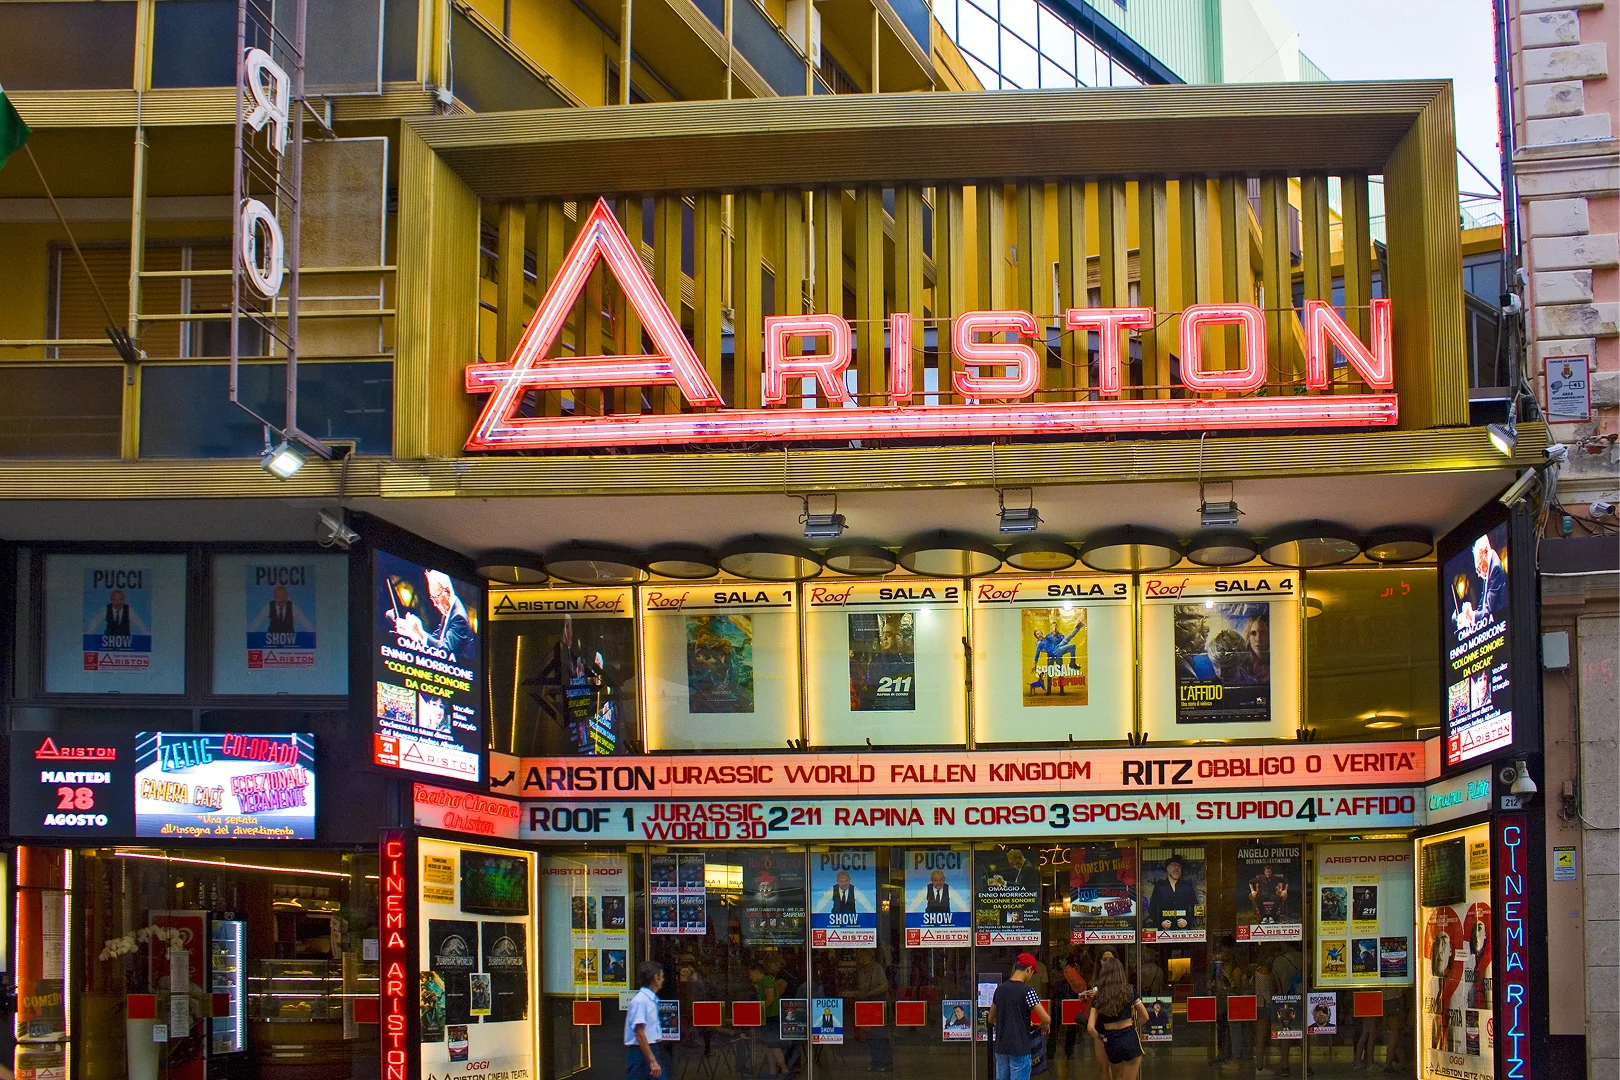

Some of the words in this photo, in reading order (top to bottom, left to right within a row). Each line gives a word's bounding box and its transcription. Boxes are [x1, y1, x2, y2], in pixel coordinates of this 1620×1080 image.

[464, 198, 1399, 452] ARISTON
[93, 569, 142, 589] PUCCI
[256, 567, 305, 585] PUCCI
[811, 586, 854, 607] Roof
[879, 588, 936, 600] SALA
[944, 587, 958, 599] 2
[978, 582, 1022, 604] Roof
[1047, 584, 1105, 596] SALA
[1114, 583, 1127, 594] 3
[1145, 578, 1190, 600] Roof
[1214, 579, 1271, 592] SALA
[1278, 578, 1293, 590] 4
[493, 594, 579, 614] ARISTON
[582, 594, 625, 614] Roof
[647, 591, 690, 612] Roof
[713, 591, 770, 604] SALA
[782, 590, 792, 602] 1
[1458, 617, 1488, 642] OMAGGIO
[1488, 614, 1494, 624] A
[102, 635, 132, 647] SHOW
[265, 633, 296, 645] SHOW
[1450, 643, 1468, 660] ENNIO
[1468, 621, 1506, 650] MORRICONE
[1480, 636, 1505, 657] SONORE
[263, 651, 314, 664] ARISTON
[397, 637, 447, 660] OMAGGIO
[448, 652, 456, 662] A
[98, 653, 149, 667] ARISTON
[380, 645, 414, 663] ENNIO
[415, 655, 474, 681] MORRICONE
[1463, 666, 1472, 678] DA
[405, 678, 419, 690] DA
[433, 674, 471, 692] SONORE
[877, 677, 912, 692] 211
[1181, 685, 1223, 701] L'AFFIDO
[35, 736, 116, 760] ARISTON
[1462, 725, 1509, 753] ARISTON
[159, 737, 213, 772] ZELIG
[222, 732, 300, 768] COLORADO
[402, 743, 476, 774] ARISTON
[41, 771, 111, 785] MARTEDI
[522, 766, 655, 791] ARISTON
[658, 764, 774, 785] JURASSIC
[784, 764, 875, 784] WORLD
[890, 763, 976, 783] FALLEN
[988, 761, 1092, 781] KINGDOM
[1121, 759, 1194, 786] RITZ
[1197, 755, 1295, 779] OBBLIGO
[1305, 754, 1322, 774] O
[1332, 751, 1417, 773] VERITA'
[229, 767, 310, 797] ECCEZIONALE
[57, 787, 94, 810] 28
[140, 778, 189, 805] CAMERA
[193, 784, 226, 811] CAFÈ
[236, 787, 308, 815] VERAMENTE
[414, 785, 462, 809] Teatro
[462, 793, 519, 818] Cinema
[1429, 789, 1463, 811] Cinema
[1466, 780, 1490, 801] Ritz
[1505, 798, 1518, 807] 212
[44, 813, 108, 827] AGOSTO
[530, 806, 612, 832] ROOF
[622, 807, 635, 832] 1
[646, 803, 764, 822] JURASSIC
[767, 806, 790, 831] 2
[790, 807, 822, 826] 211
[834, 807, 924, 826] RAPINA
[933, 807, 956, 825] IN
[964, 804, 1046, 826] CORSO
[1048, 803, 1071, 828] 3
[1072, 801, 1185, 831] SPOSAMI,
[1195, 799, 1294, 820] STUPIDO
[1295, 797, 1318, 822] 4
[1318, 795, 1416, 816] L'AFFIDO
[214, 824, 230, 835] del
[640, 822, 729, 840] WORLD
[736, 821, 768, 840] 3D
[820, 853, 867, 871] PUCCI
[914, 852, 961, 870] PUCCI
[1237, 848, 1270, 859] ANGELO
[1271, 847, 1300, 857] PINTUS
[1324, 856, 1376, 864] ARISTON
[542, 868, 591, 876] ARISTON
[593, 868, 623, 876] ROOF
[1075, 860, 1110, 874] COMEDY
[387, 842, 404, 948] CINEMA
[1503, 826, 1524, 971] CINEMA
[612, 917, 625, 925] 211
[829, 913, 859, 925] SHOW
[923, 912, 953, 924] SHOW
[828, 930, 874, 942] ARISTON
[921, 929, 969, 941] ARISTON
[992, 932, 1038, 942] ARISTON
[1086, 931, 1134, 941] ARISTON
[1157, 931, 1205, 940] ARISTON
[1251, 925, 1300, 936] ARISTON
[456, 956, 475, 966] WORLD
[505, 956, 524, 966] WORLD
[816, 999, 839, 1008] PUCCI
[387, 962, 405, 1080] ARISTON
[1507, 984, 1525, 1079] RITZ
[466, 1061, 490, 1071] OGGI
[1449, 1055, 1464, 1065] OGGI
[1434, 1062, 1462, 1078] ARISTON
[1463, 1071, 1478, 1080] RITZ
